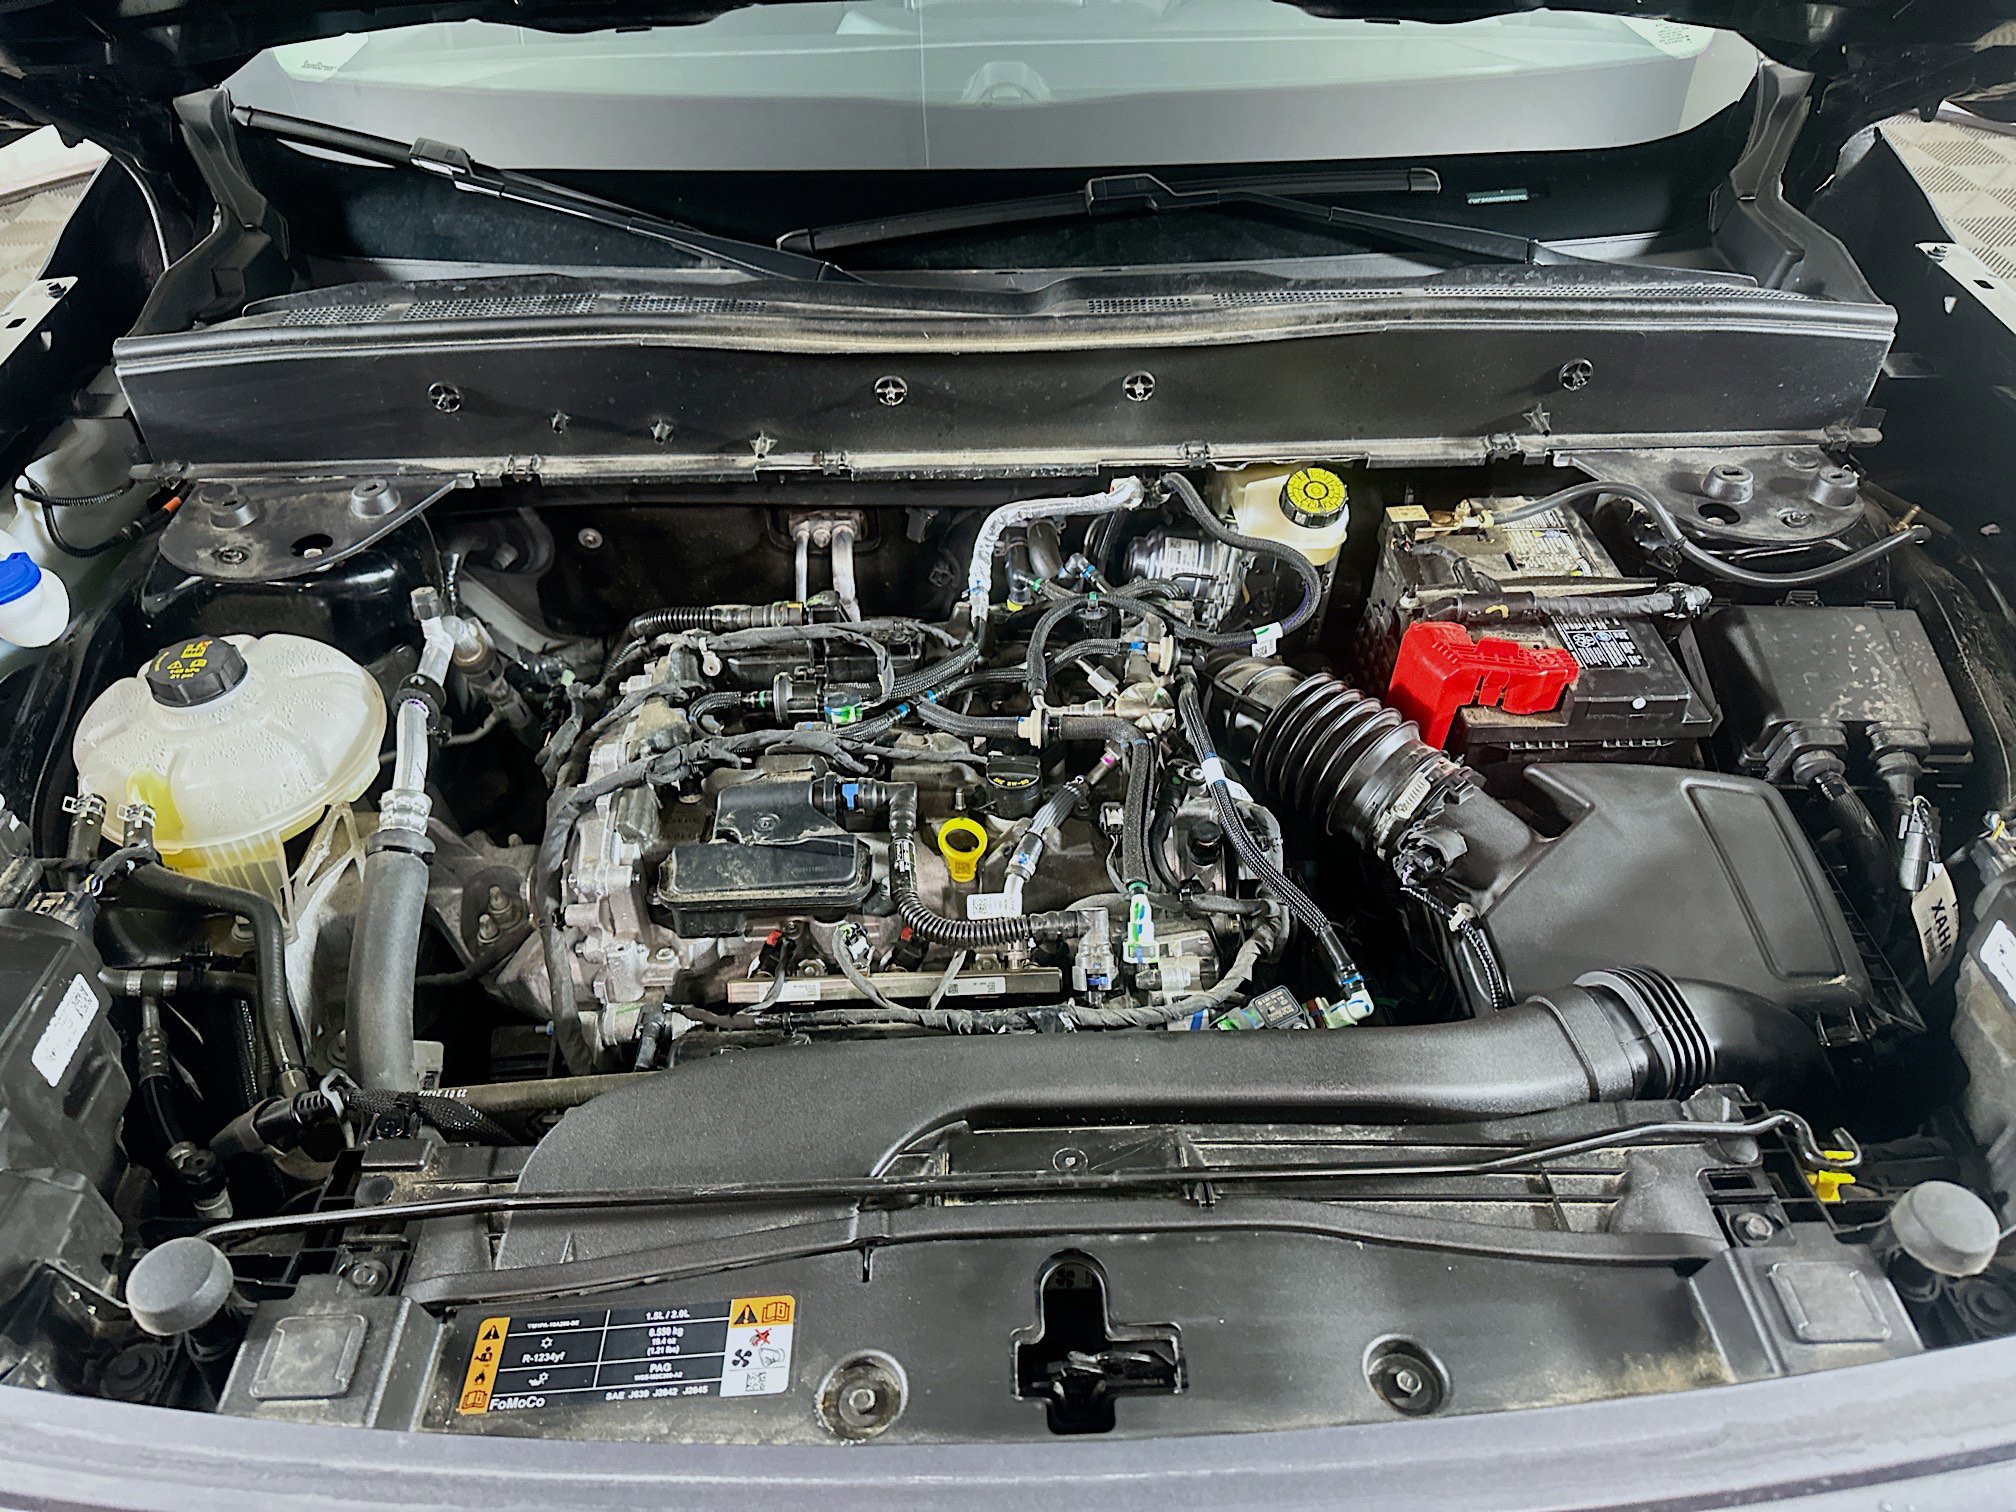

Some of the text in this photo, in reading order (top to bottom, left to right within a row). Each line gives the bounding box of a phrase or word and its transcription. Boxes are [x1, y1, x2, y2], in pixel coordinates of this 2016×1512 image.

[646, 1311, 665, 1321] 1.5L
[671, 1308, 691, 1319] 2.0L
[672, 1326, 684, 1338] kg
[521, 1350, 566, 1364] R-1234yf
[649, 1362, 673, 1374] PAG
[605, 1391, 625, 1401] SAE
[627, 1389, 650, 1399] J639
[489, 1395, 546, 1411] FoMoCo
